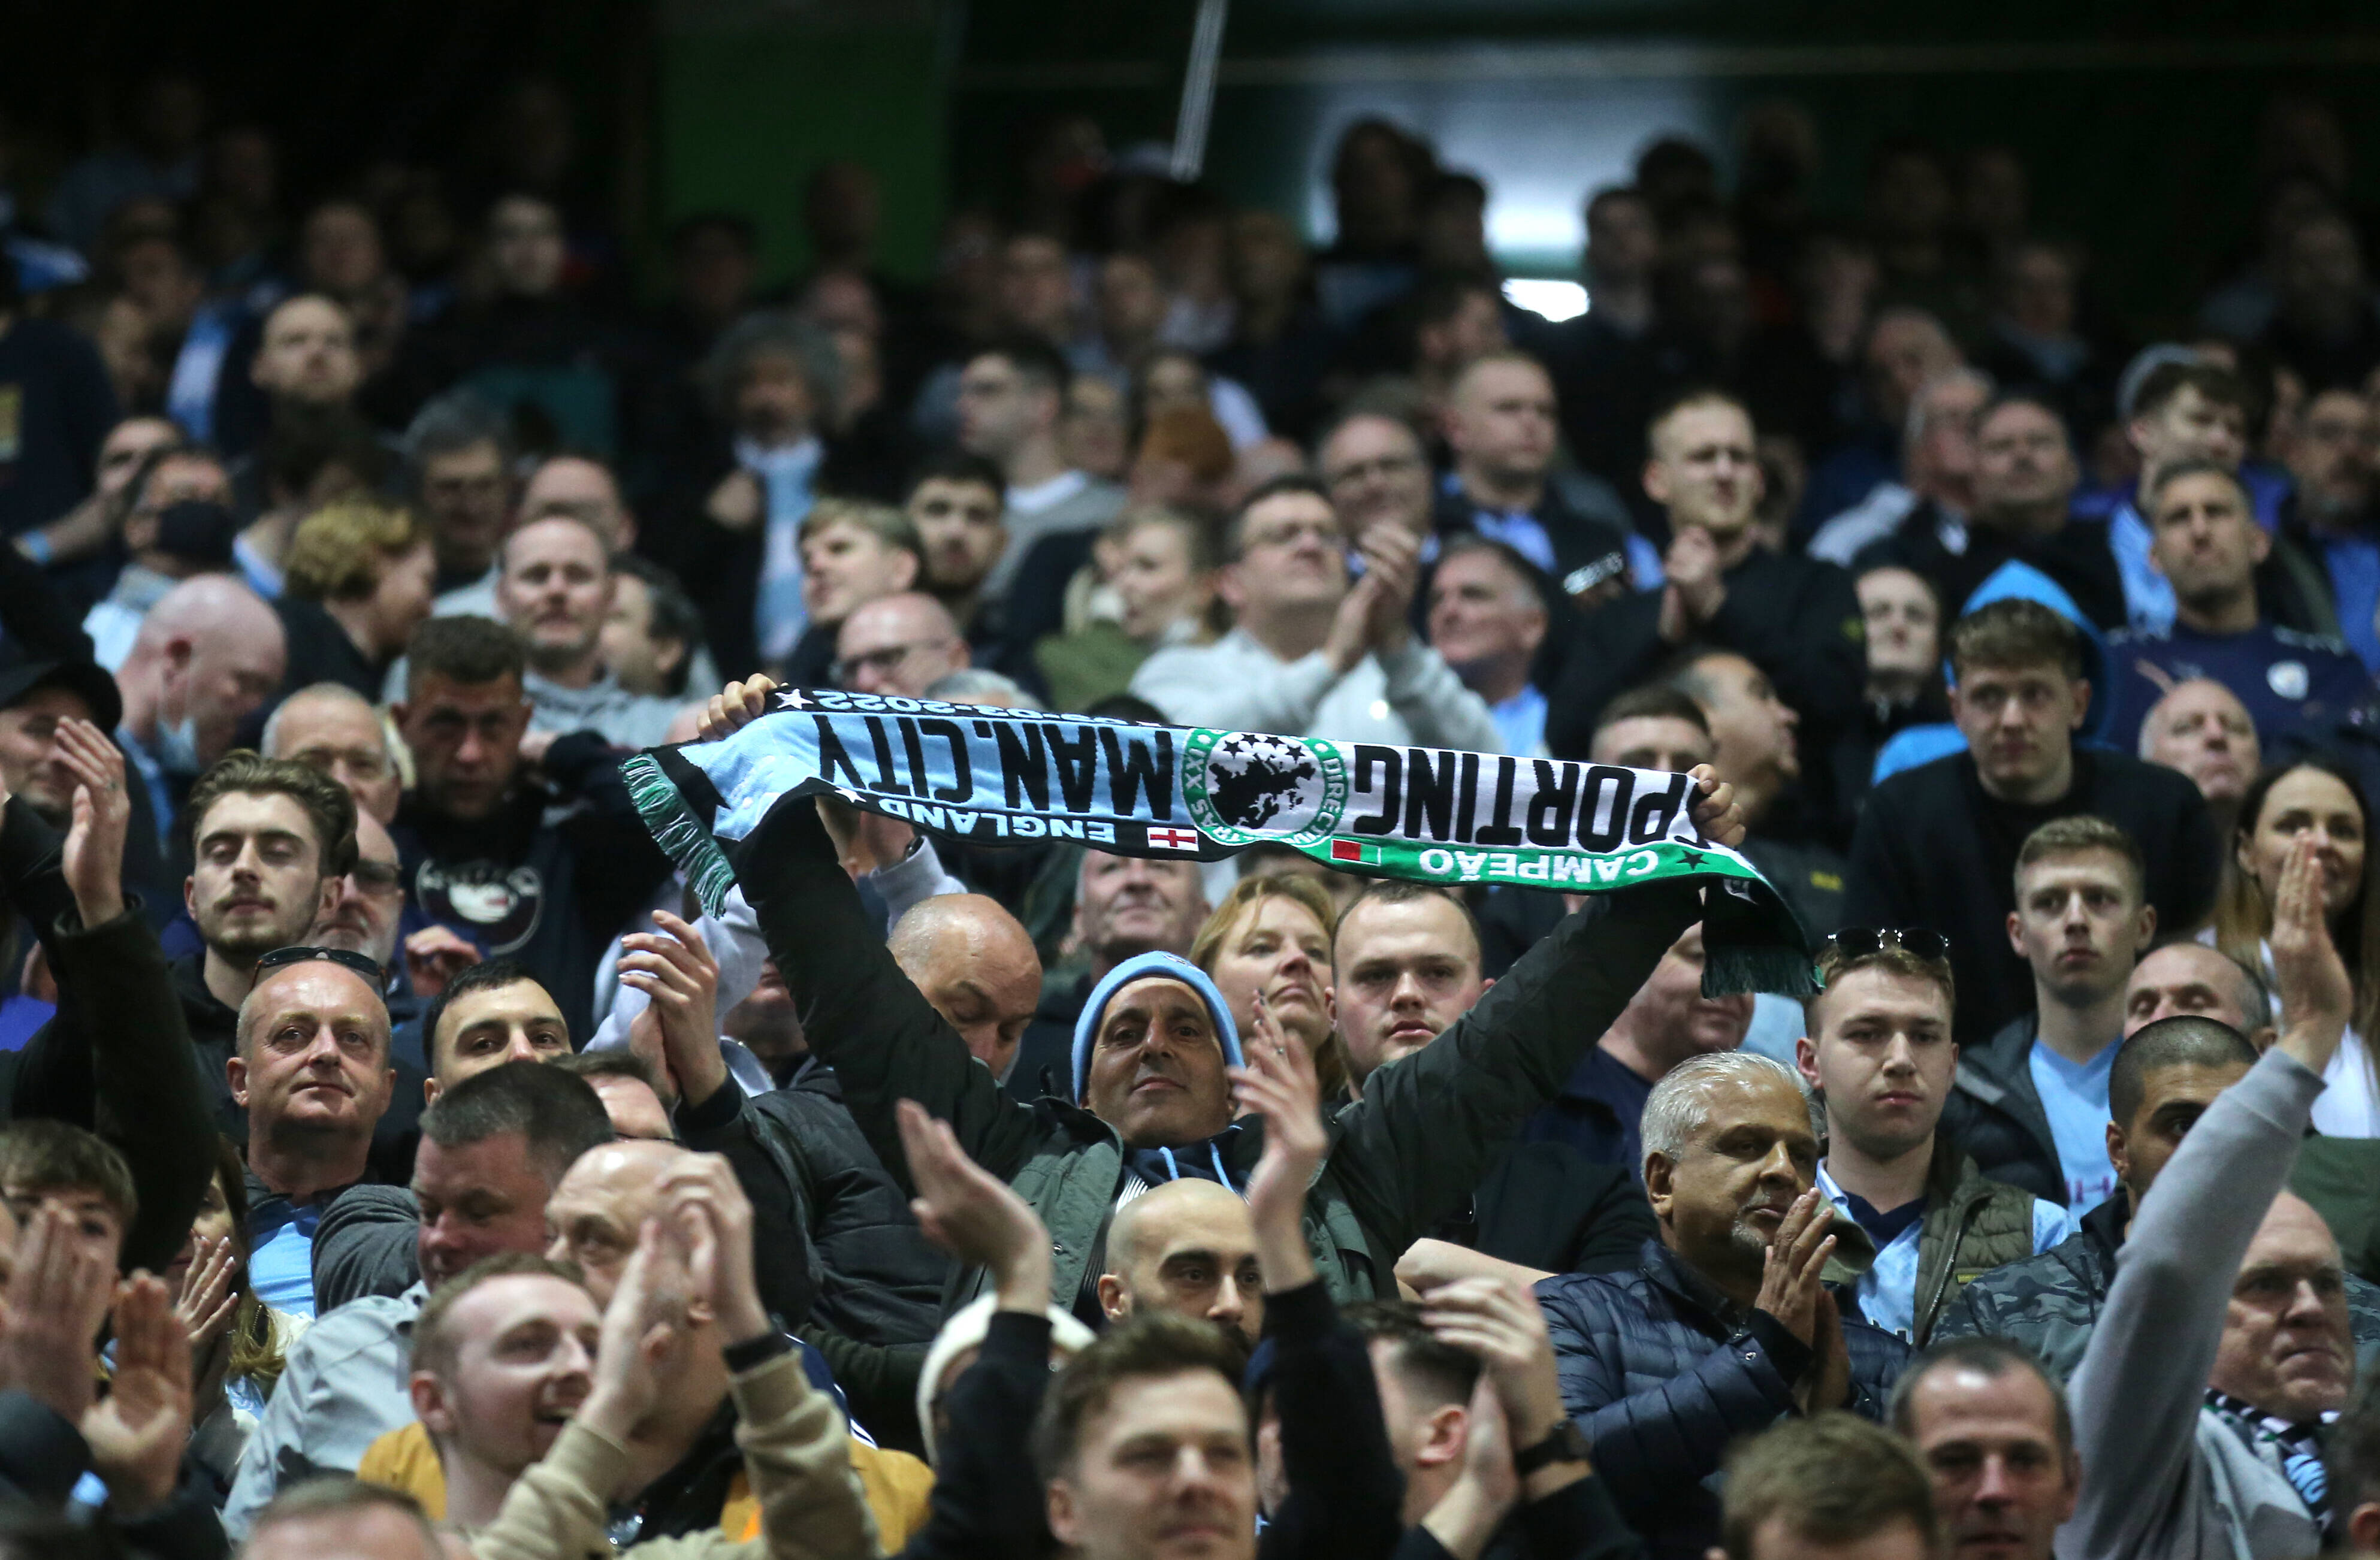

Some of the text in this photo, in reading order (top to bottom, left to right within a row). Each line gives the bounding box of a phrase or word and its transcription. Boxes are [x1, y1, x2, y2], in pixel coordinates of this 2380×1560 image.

[812, 714, 1173, 821] MAN.CITY
[1185, 748, 1207, 790] XXI
[878, 798, 1116, 844] ENGLAND
[1419, 848, 1659, 882] CAMPEÃO
